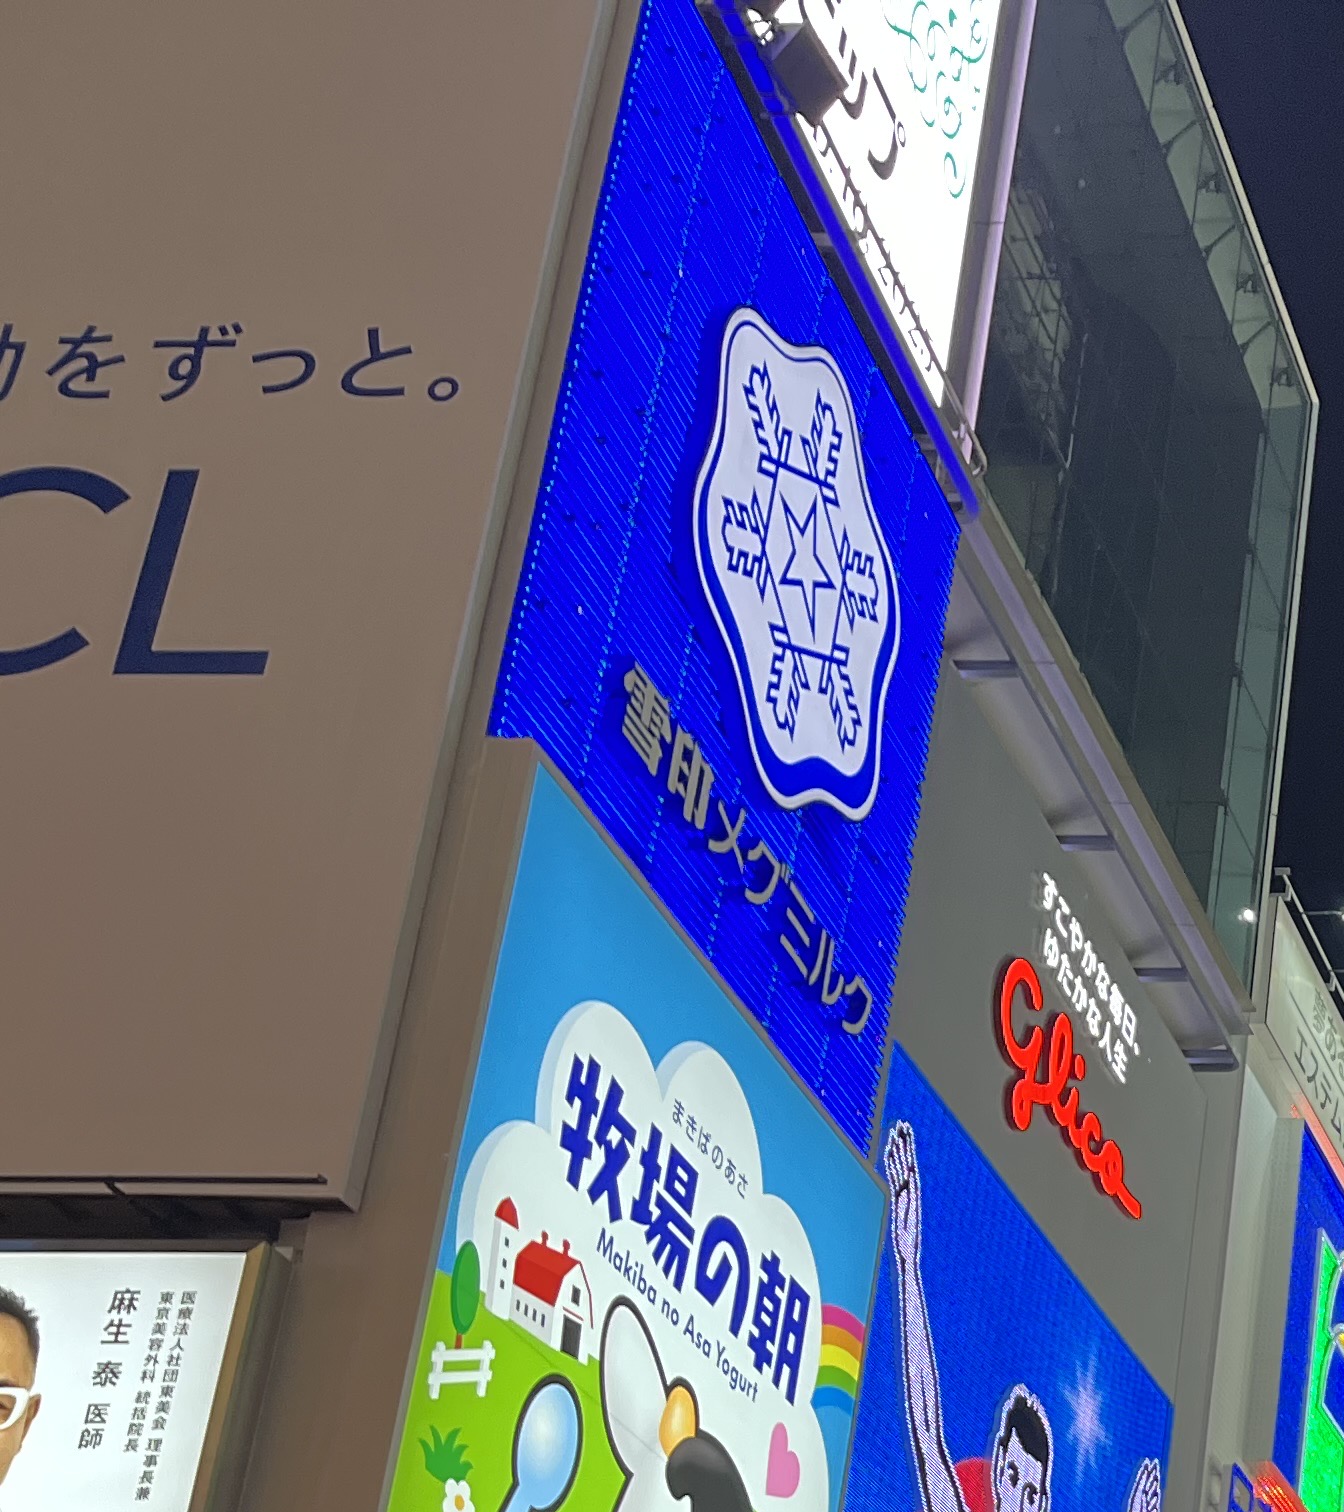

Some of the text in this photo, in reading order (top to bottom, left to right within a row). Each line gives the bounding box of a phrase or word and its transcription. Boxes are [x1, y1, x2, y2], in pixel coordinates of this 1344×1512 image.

[621, 661, 874, 1035] 雪印メグミルク
[1042, 872, 1140, 1055] すこやかな毎日、
[1042, 929, 1127, 1084] ゆたかな人生
[672, 1099, 750, 1199] まきばのあさ
[1001, 957, 1142, 1219] Glico
[559, 1053, 811, 1406] 牧場の朝
[78, 1288, 141, 1451] 麻生 泰 医師
[140, 1291, 175, 1384] 東京美容外科
[150, 1290, 198, 1432] 医療法人社団東美会
[597, 1228, 758, 1403] Makiba no Asa Yogurt
